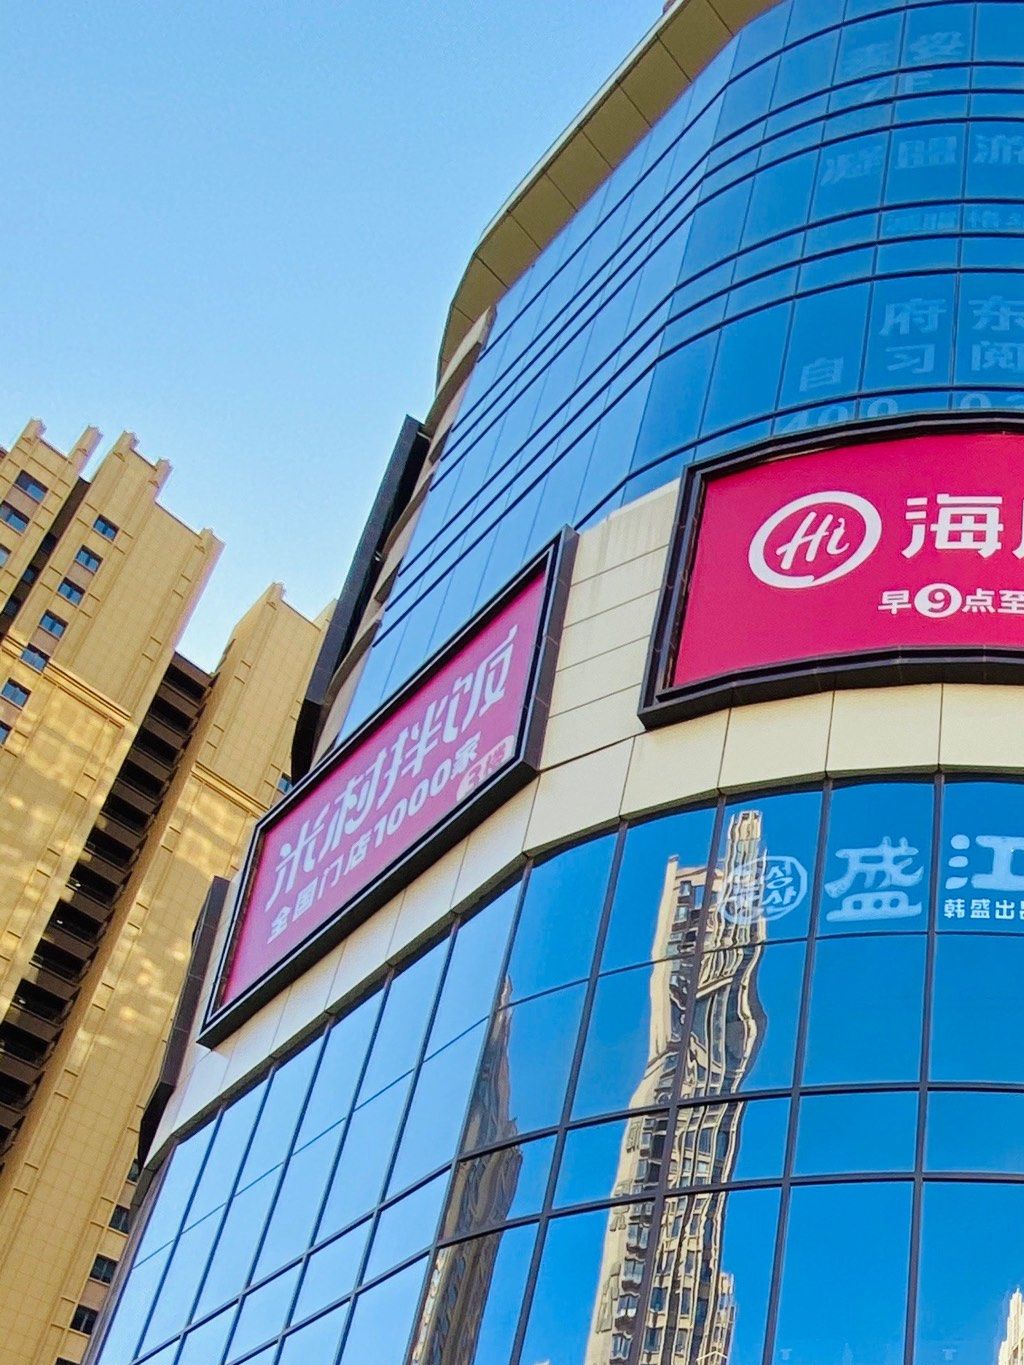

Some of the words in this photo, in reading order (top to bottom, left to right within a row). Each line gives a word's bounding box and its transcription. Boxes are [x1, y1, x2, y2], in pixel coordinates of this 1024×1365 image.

[264, 624, 518, 911] 米村拌饭
[267, 731, 482, 945] 全国门店1000家
